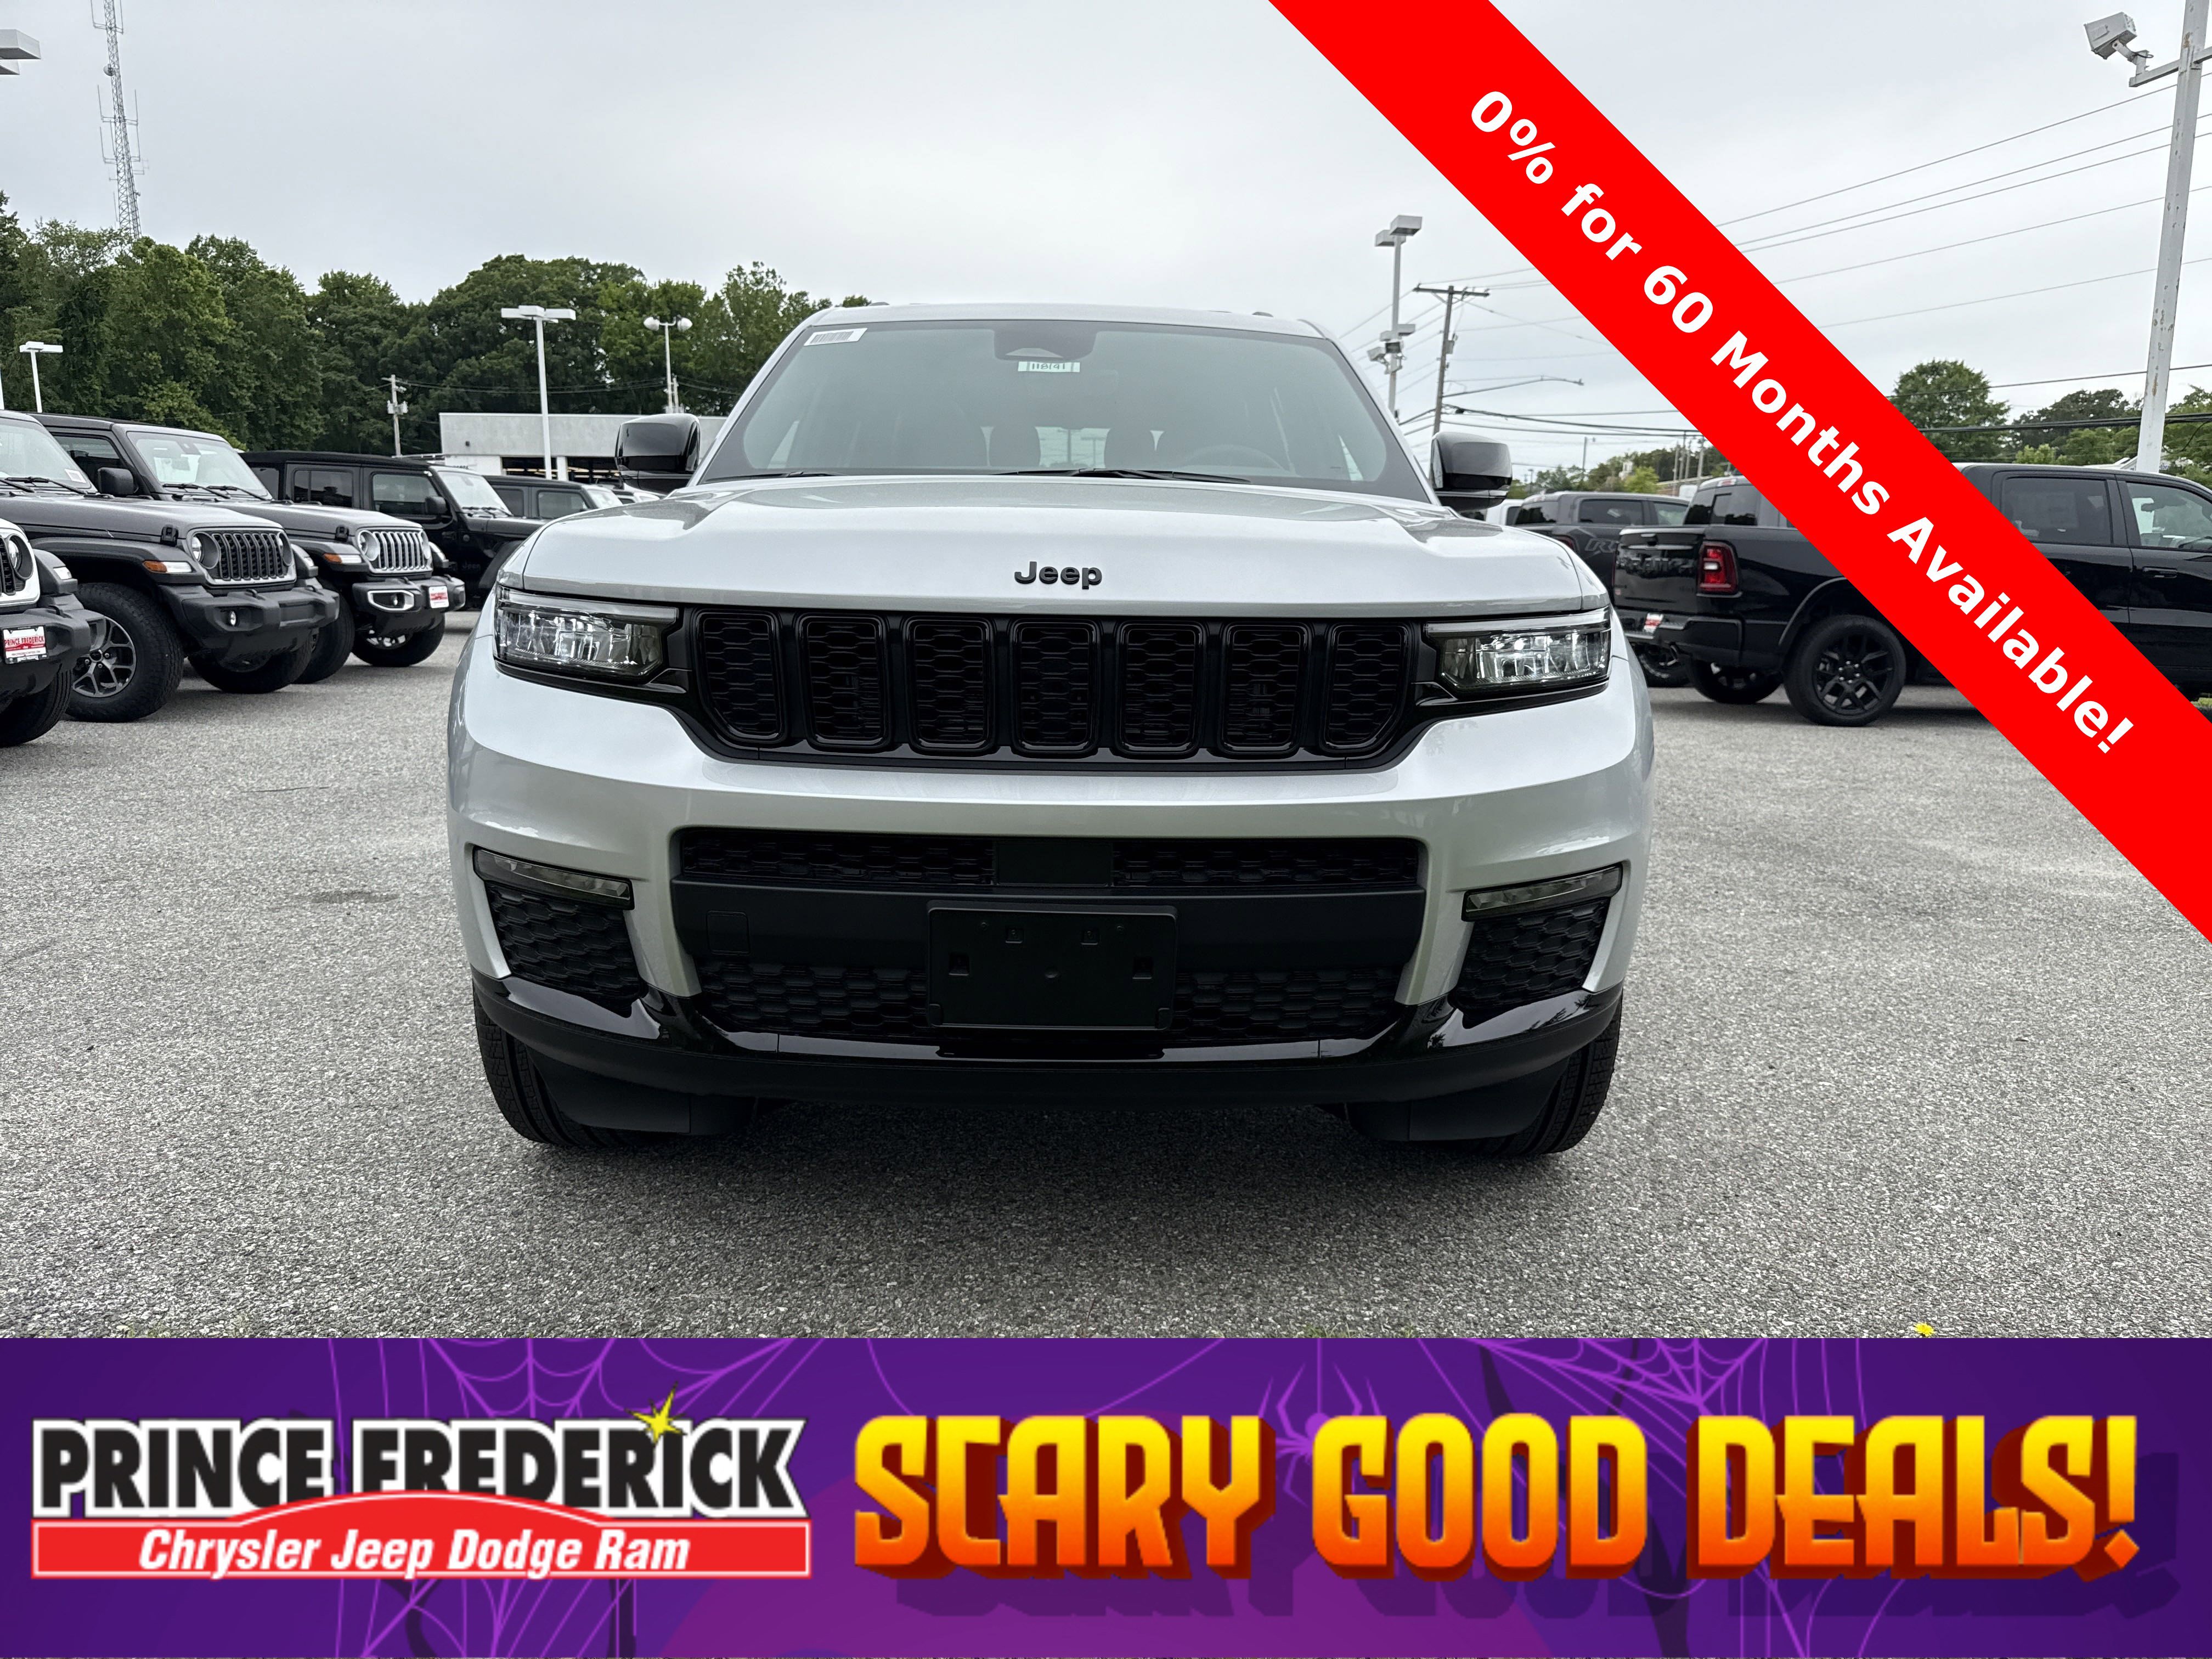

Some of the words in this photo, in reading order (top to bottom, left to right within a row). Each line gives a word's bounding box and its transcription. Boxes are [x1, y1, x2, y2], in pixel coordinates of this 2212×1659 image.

[1014, 561, 1102, 590] Jeep
[4, 638, 20, 646] PRINCE
[21, 636, 44, 644] FREDERICK
